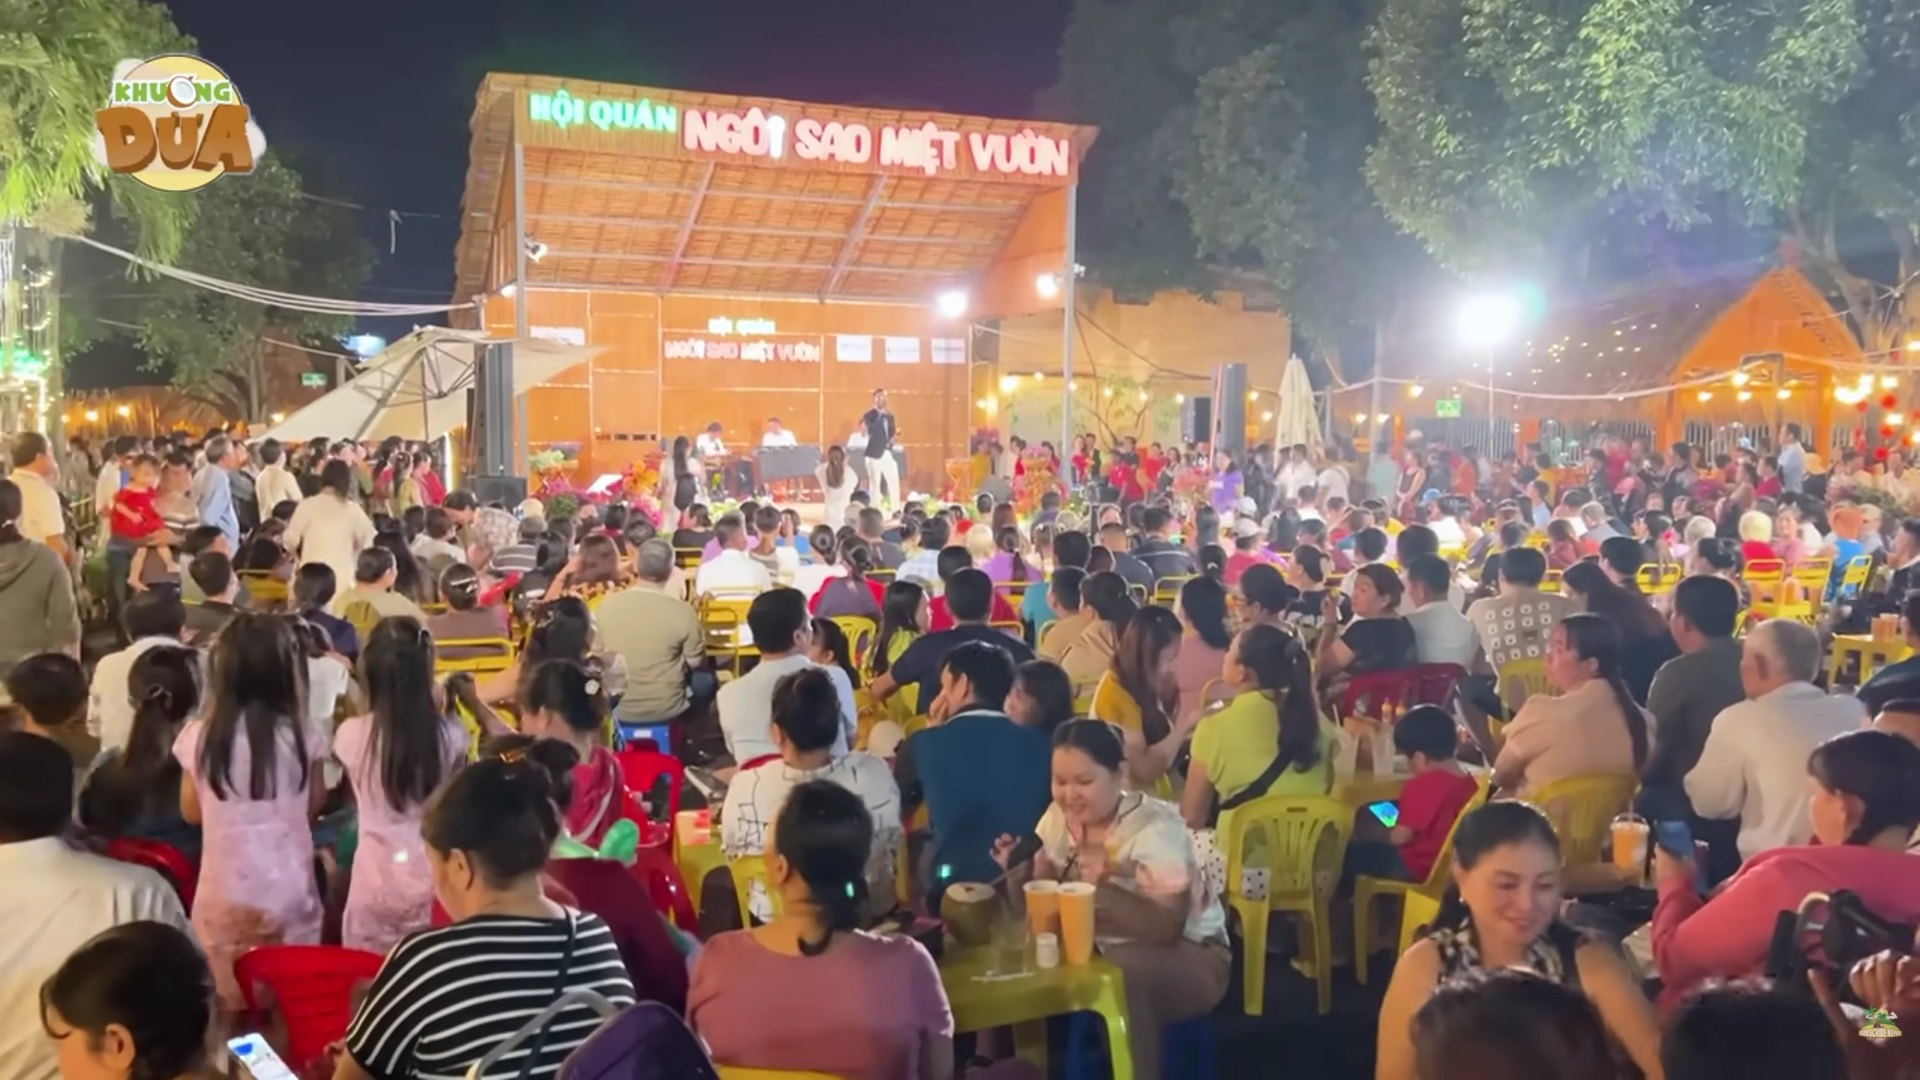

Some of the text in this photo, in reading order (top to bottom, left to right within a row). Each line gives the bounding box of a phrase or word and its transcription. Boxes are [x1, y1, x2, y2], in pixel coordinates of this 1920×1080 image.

[530, 89, 677, 132] HỘI QUÁN
[684, 107, 786, 159] NGÔI
[795, 119, 872, 164] SAO
[880, 121, 961, 176] MIỆT
